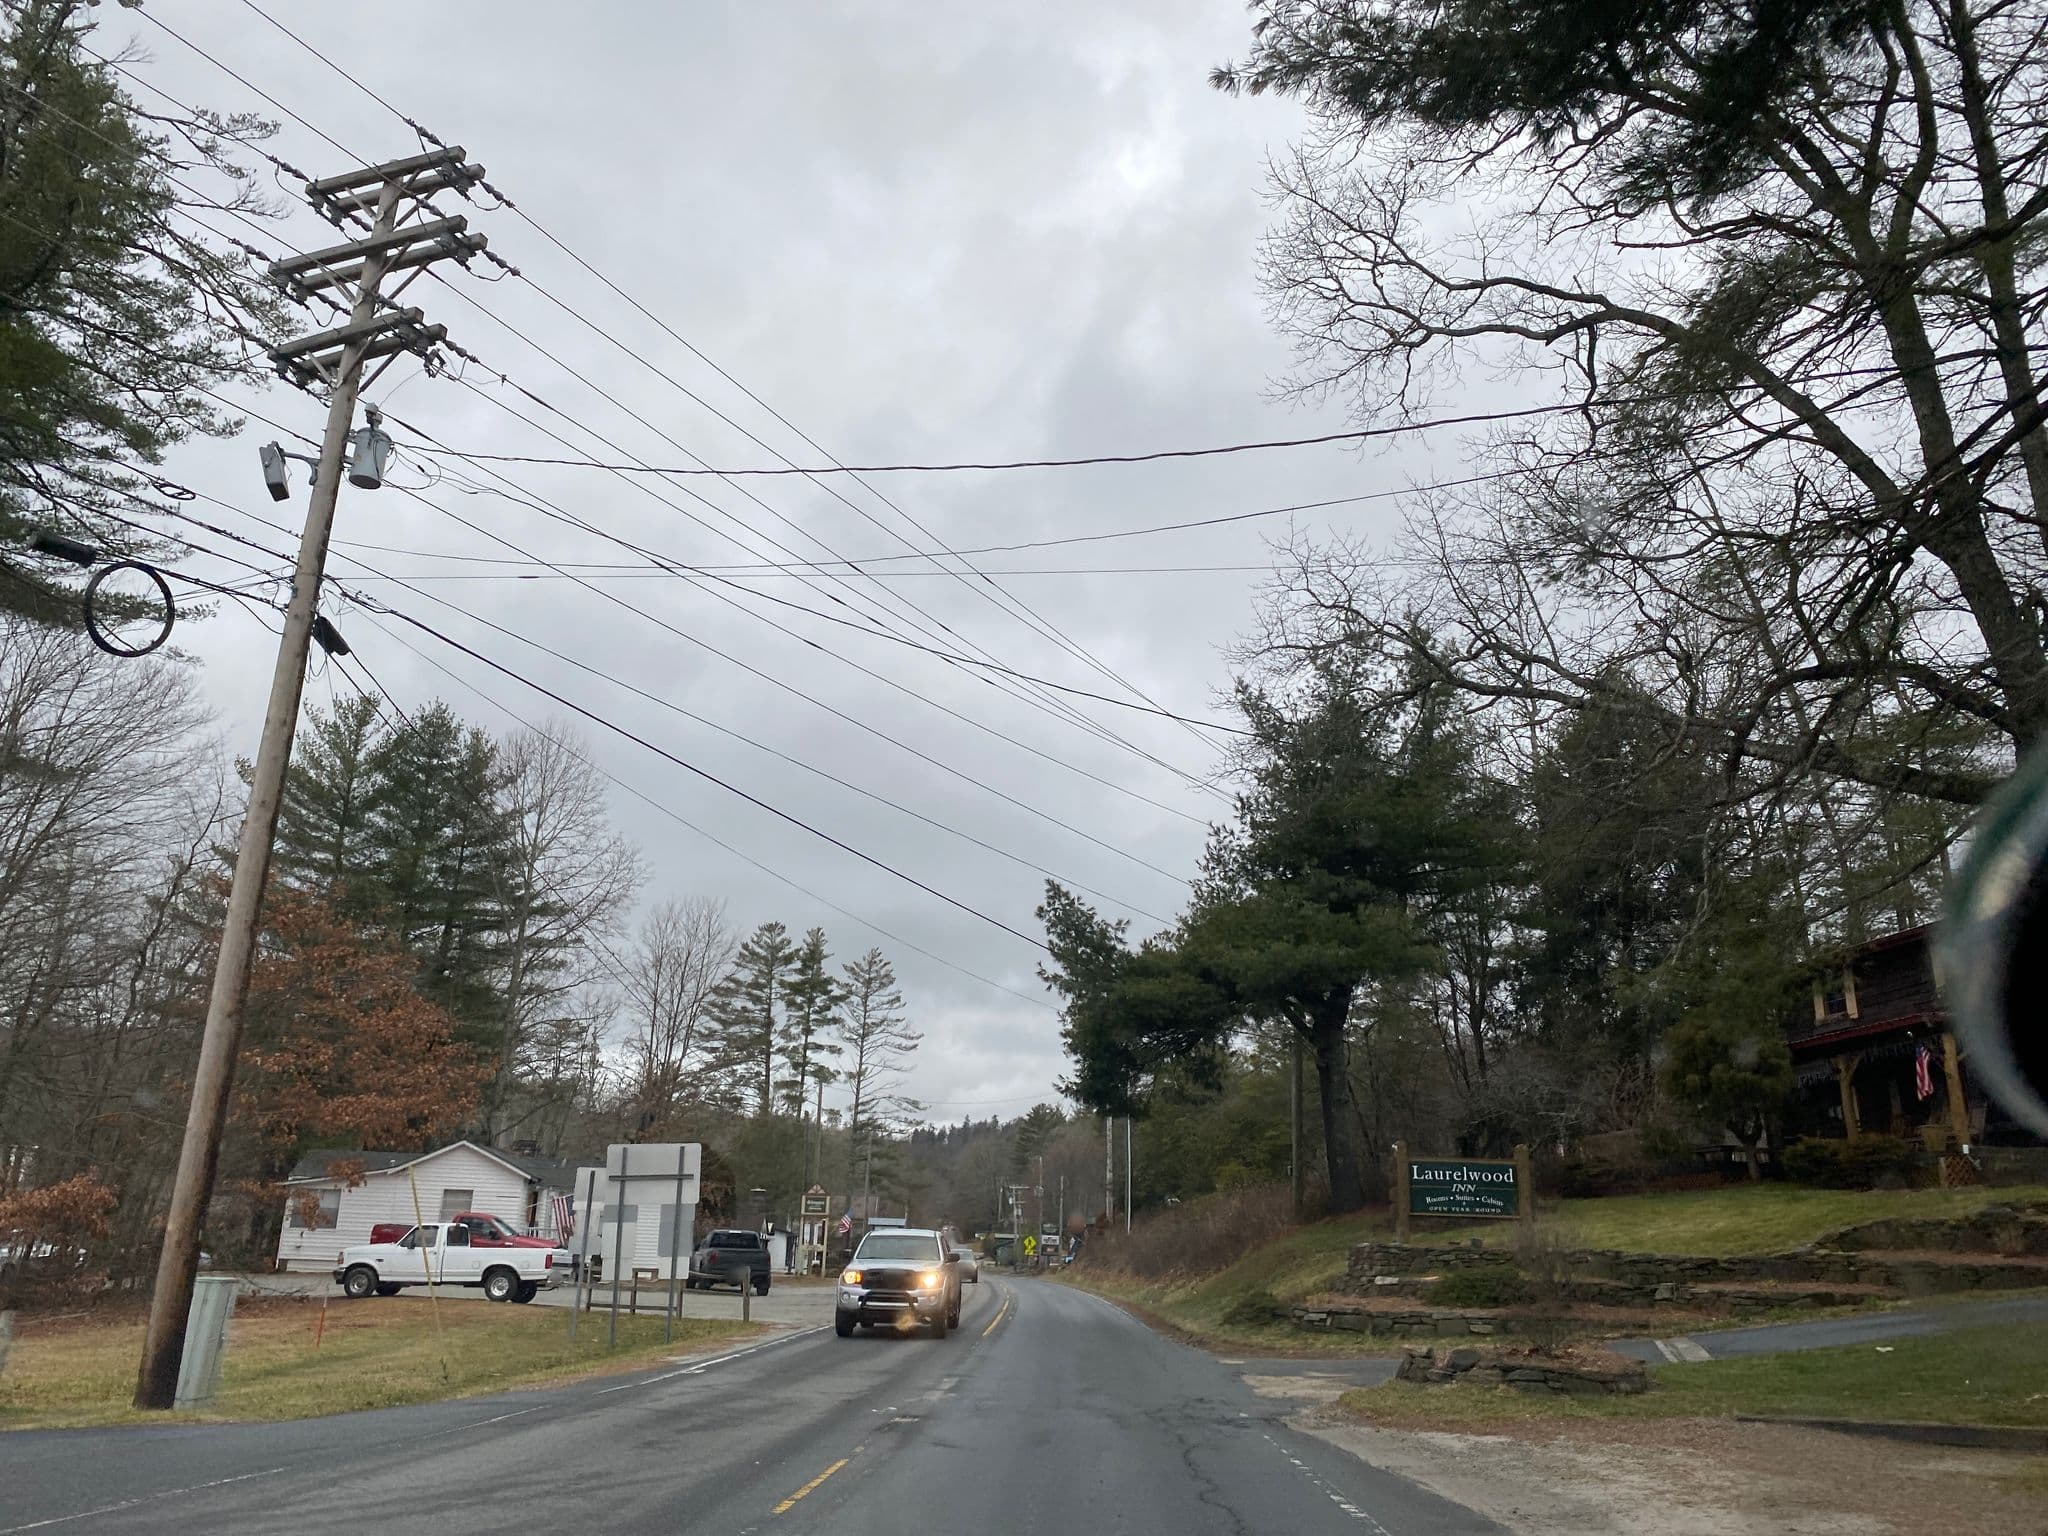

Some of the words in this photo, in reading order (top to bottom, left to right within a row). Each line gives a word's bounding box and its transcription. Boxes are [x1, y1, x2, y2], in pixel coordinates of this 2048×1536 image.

[1412, 1165, 1514, 1183] Laurelwood
[1451, 1183, 1477, 1193] INN
[1425, 1196, 1449, 1204] Rooms
